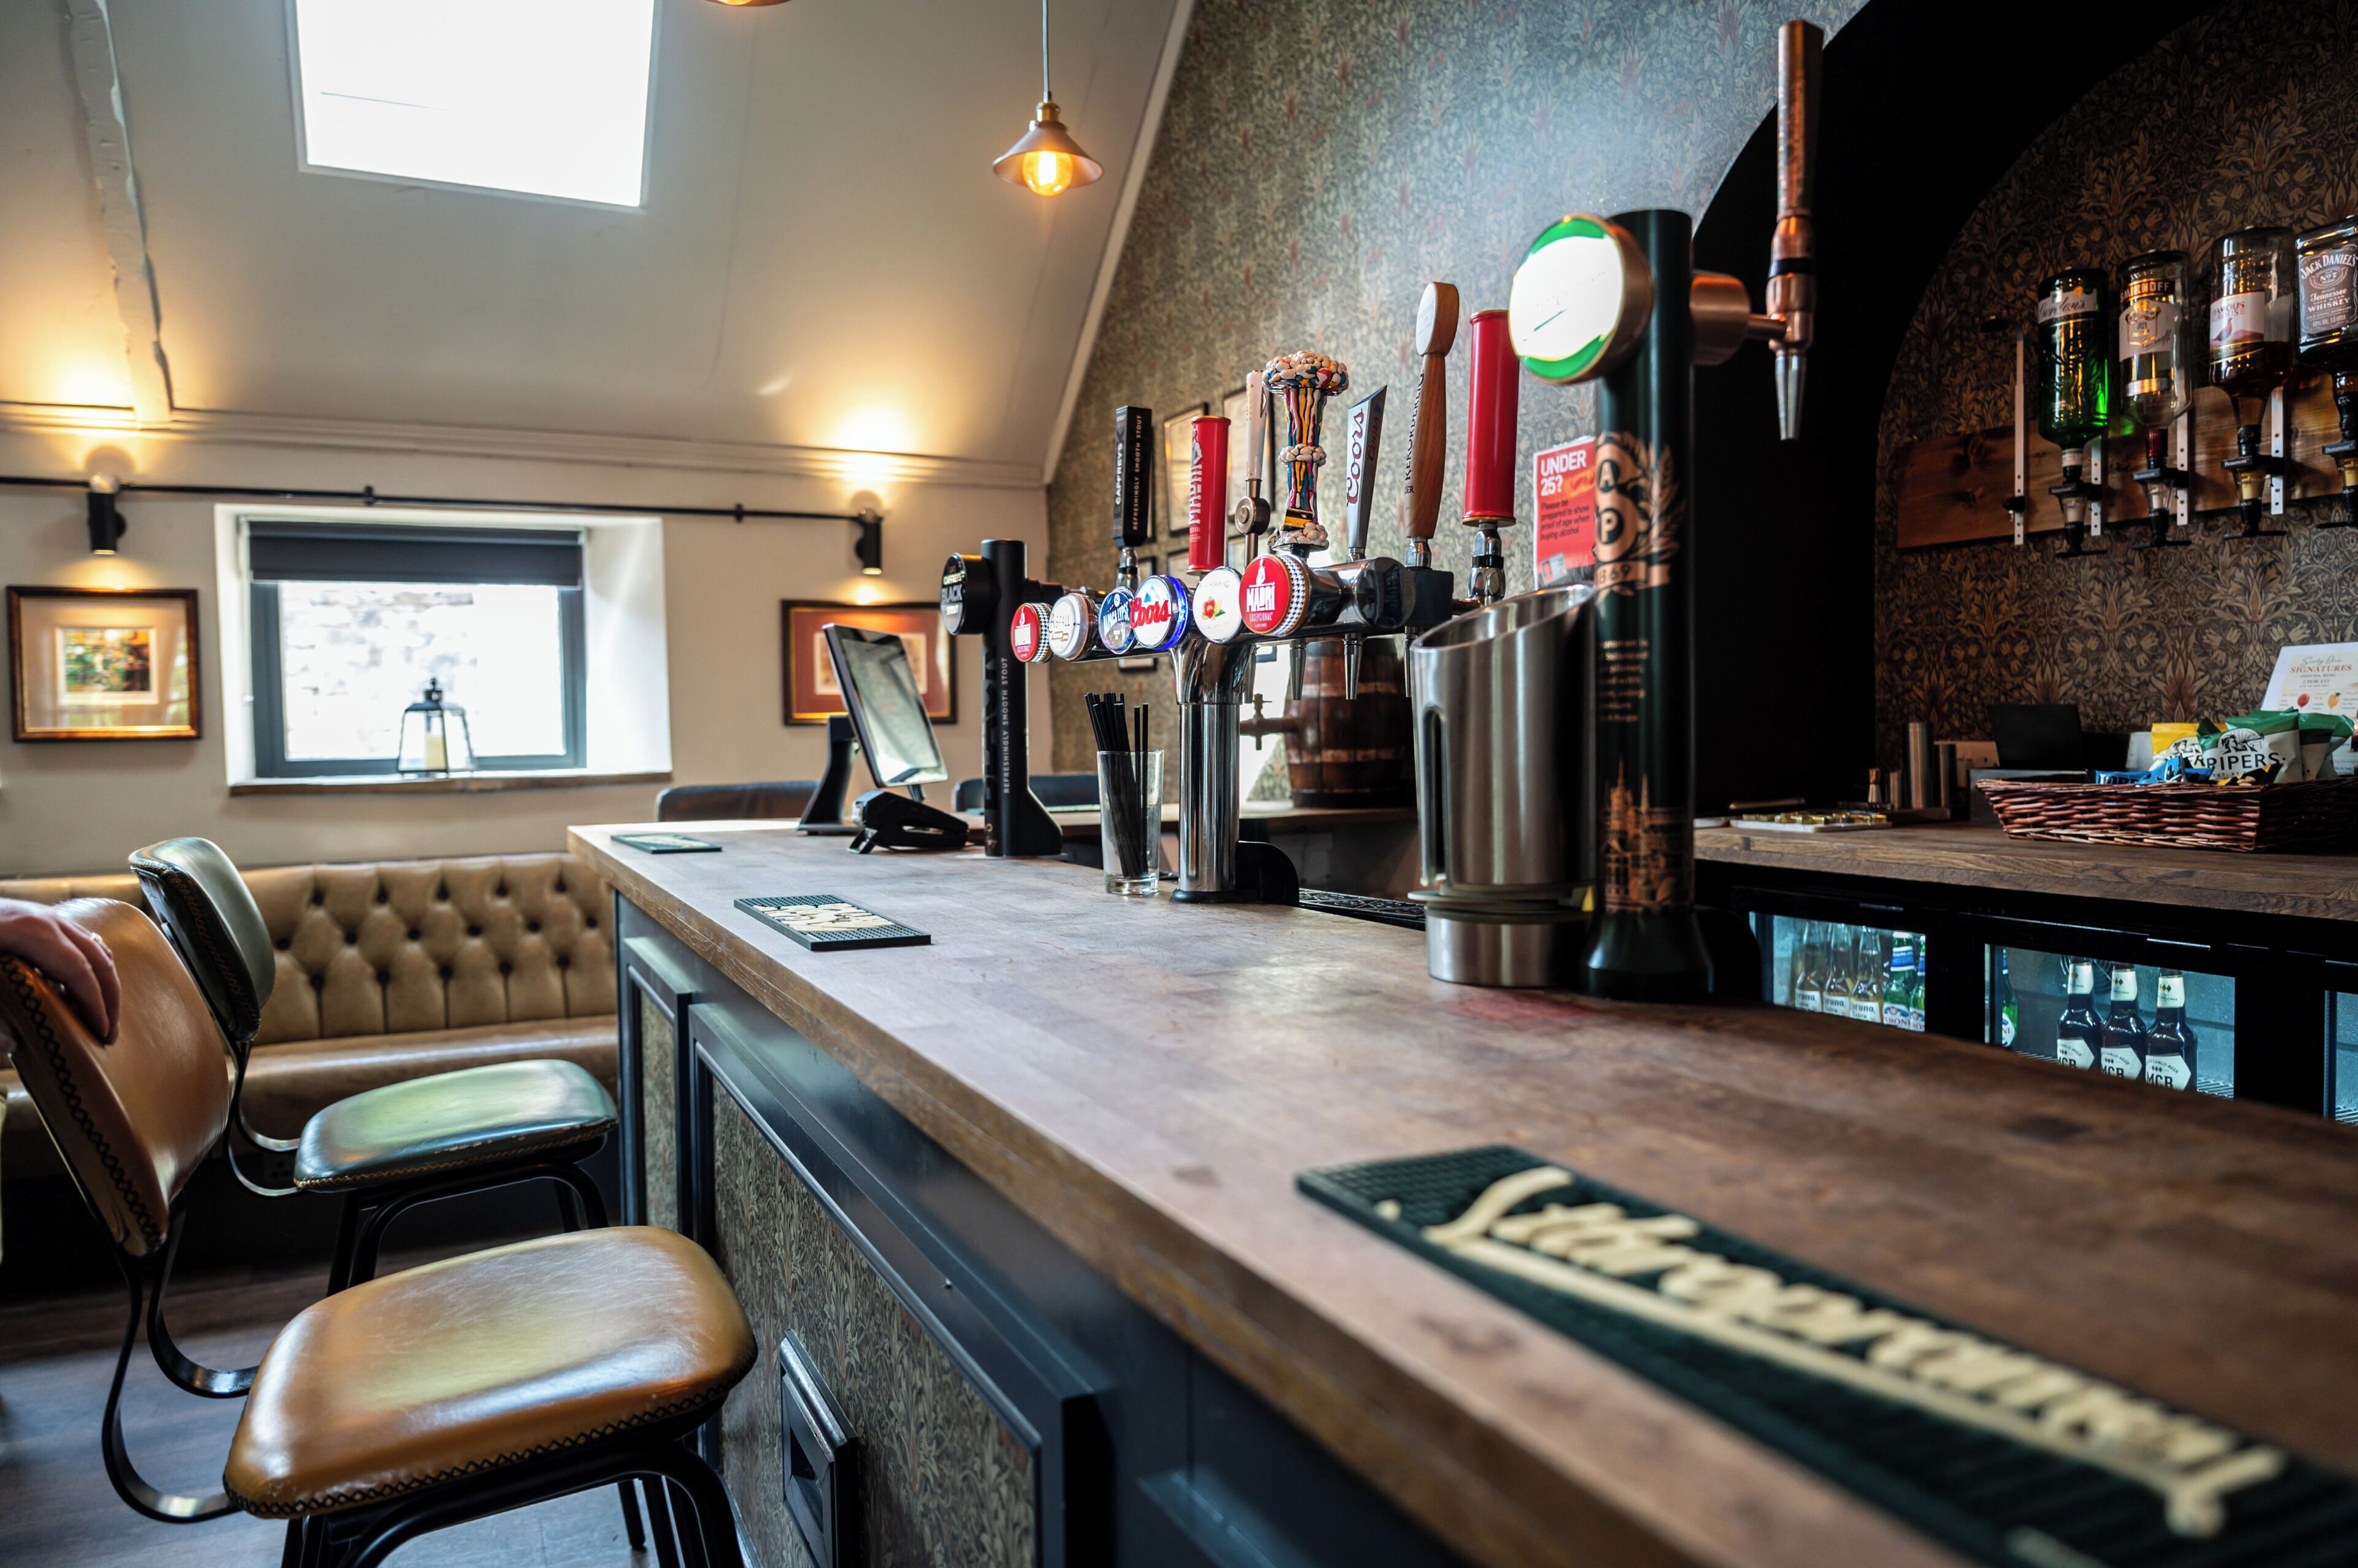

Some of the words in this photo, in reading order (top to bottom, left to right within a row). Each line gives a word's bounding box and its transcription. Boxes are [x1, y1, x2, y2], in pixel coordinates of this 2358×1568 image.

[2300, 259, 2322, 280] JACK
[2322, 254, 2358, 266] DANIEL'S
[2120, 281, 2169, 303] SMIRNOFF
[2310, 289, 2348, 303] Tennessee
[2308, 297, 2351, 313] WHISKEY
[1367, 416, 1379, 462] Coors
[2325, 444, 2350, 453] Beaumont
[1346, 408, 1364, 508] Coors
[1541, 449, 1587, 476] UNDER
[1599, 461, 1616, 489] A
[1541, 475, 1563, 497] 25?
[1541, 510, 1565, 521] prepared
[1541, 521, 1554, 531] proof
[1563, 518, 1572, 527] age
[1559, 527, 1579, 537] alcohol
[1600, 513, 1618, 543] P
[941, 584, 963, 603] BLACK
[1130, 597, 1173, 629] Coors
[1250, 612, 1273, 622] EXCEPCIONAL
[2290, 664, 2352, 673] SIGNATURES
[2119, 1056, 2130, 1066] BEER
[2167, 1064, 2179, 1074] BEER
